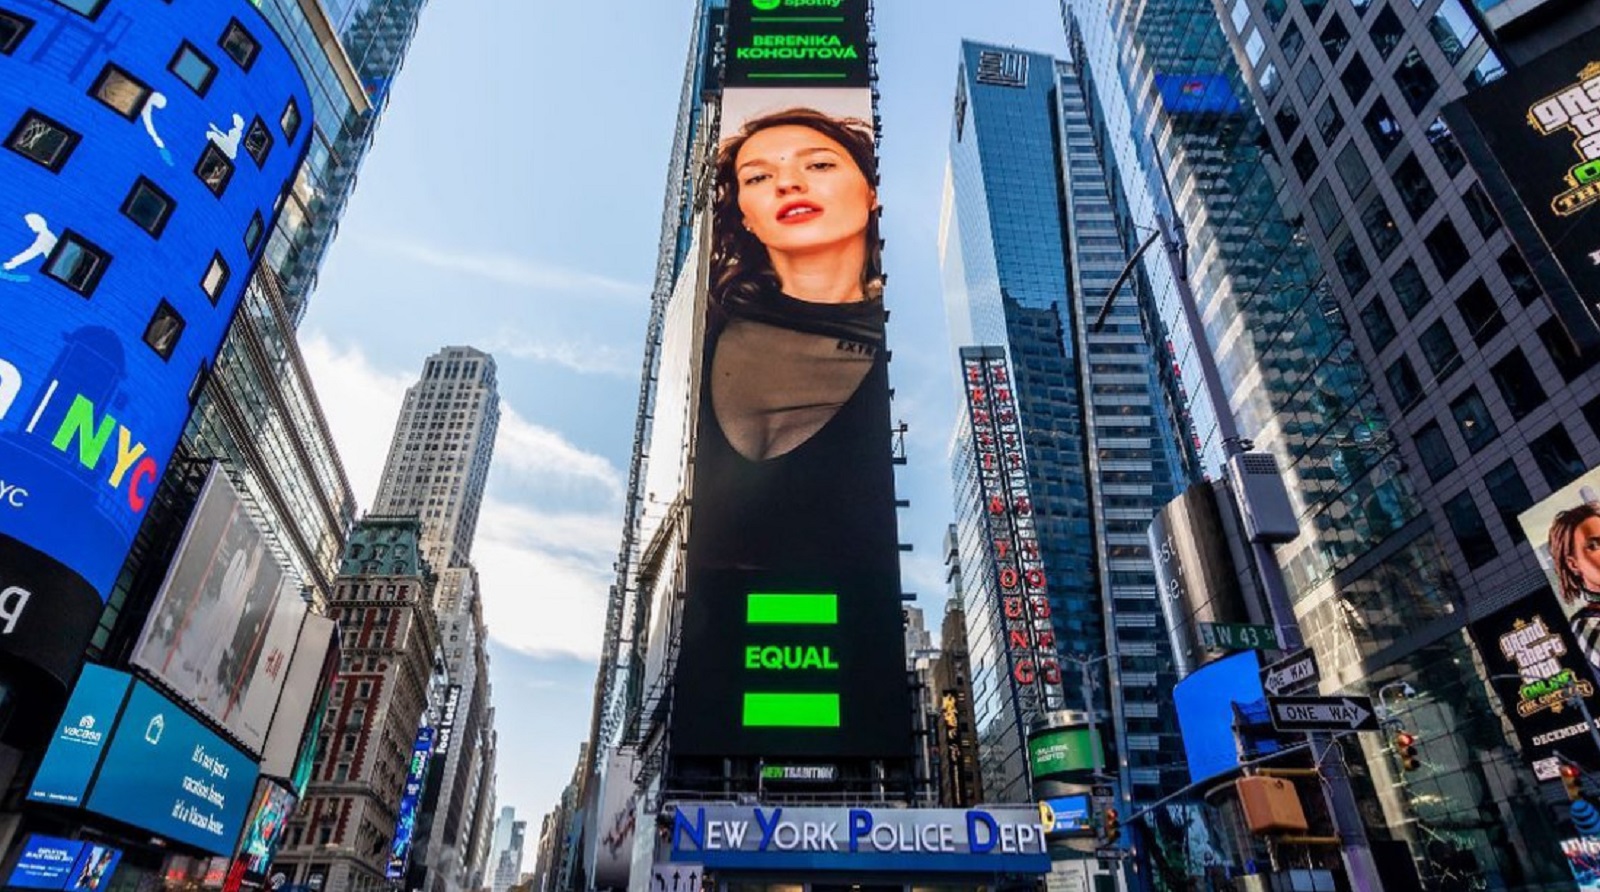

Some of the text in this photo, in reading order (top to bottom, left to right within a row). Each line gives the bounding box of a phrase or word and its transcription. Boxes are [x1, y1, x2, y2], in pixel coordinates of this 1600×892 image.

[737, 45, 858, 59] KOHOUTOVÁ
[753, 35, 841, 46] BERENIKA
[52, 393, 157, 513] NYC
[994, 539, 1034, 685] YOUNG
[1215, 625, 1233, 645] W
[1240, 626, 1260, 647] 43
[745, 645, 839, 670] EQUAL
[1269, 661, 1309, 690] ONE WAY
[441, 687, 460, 726] Locker
[1286, 706, 1359, 721] ONE WAY
